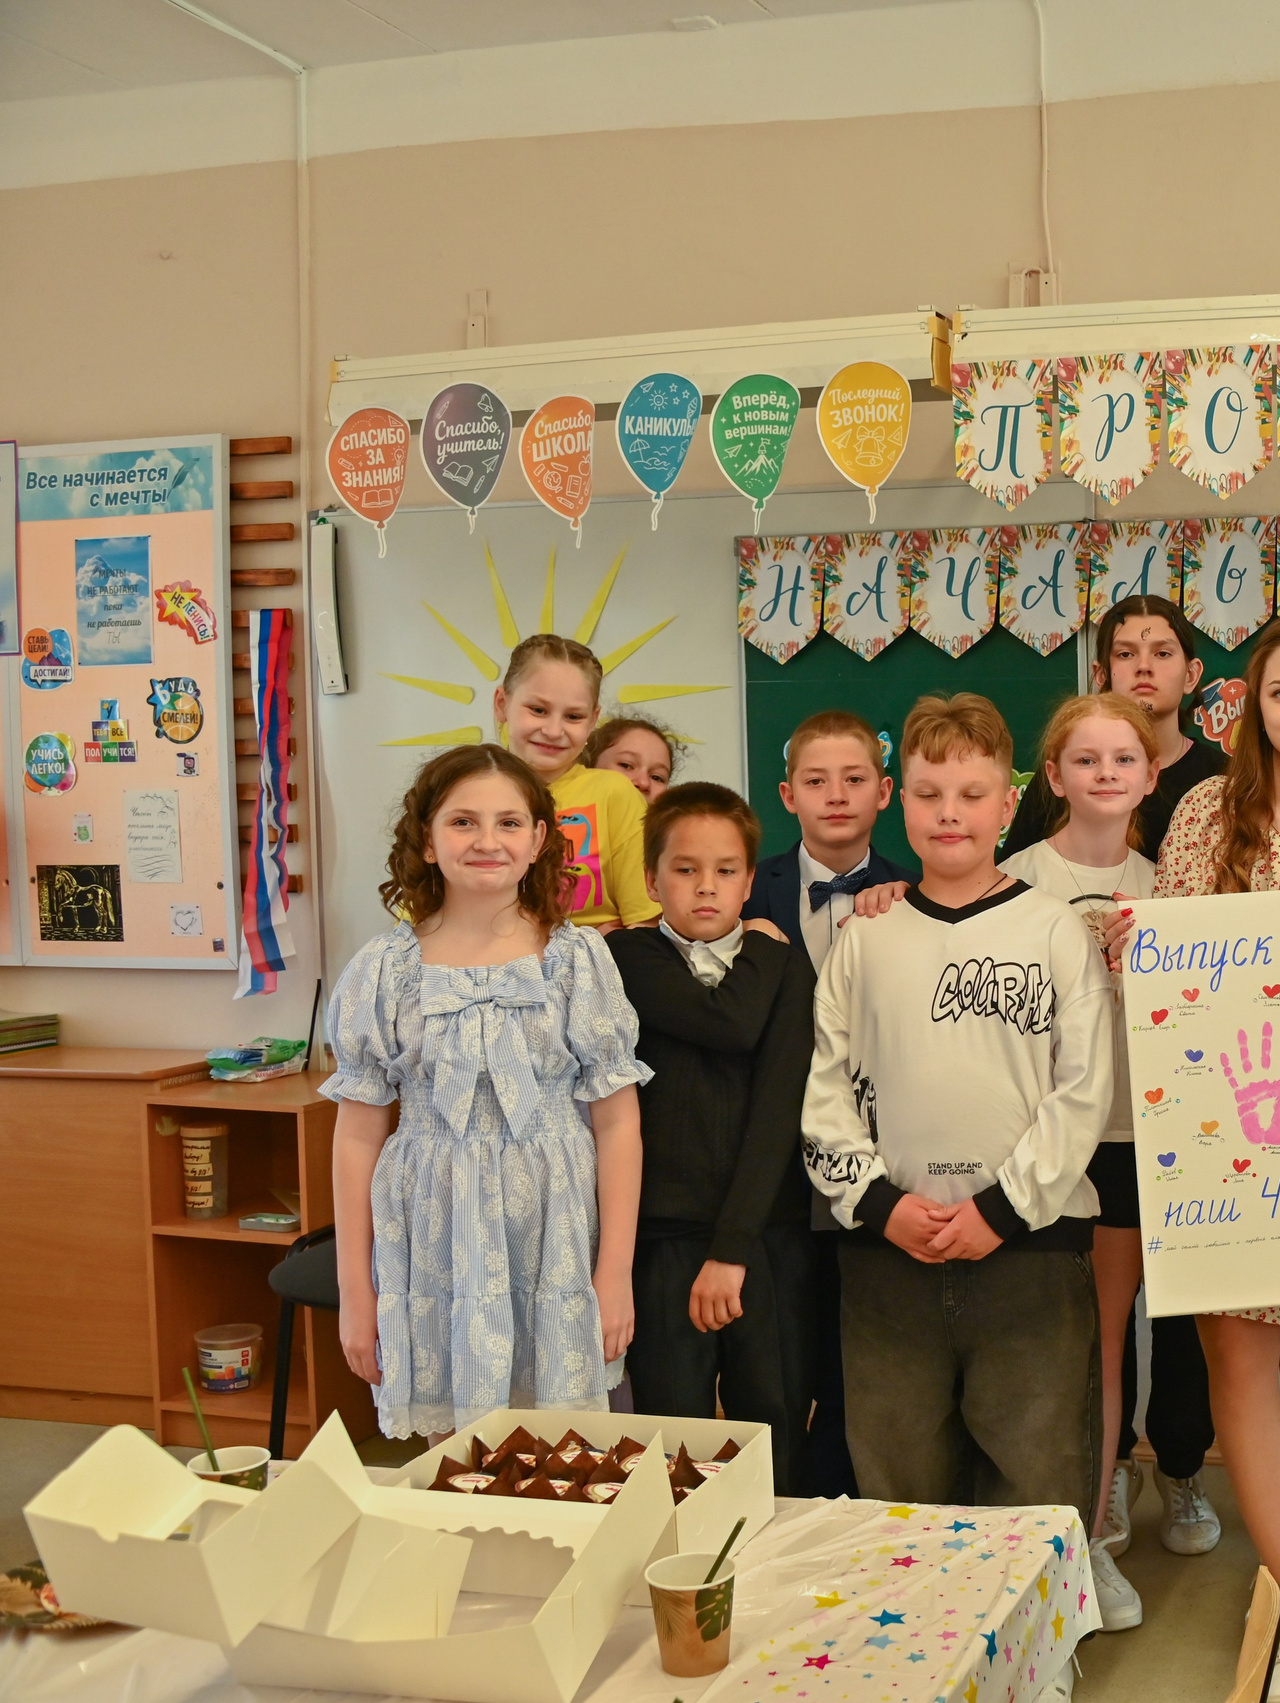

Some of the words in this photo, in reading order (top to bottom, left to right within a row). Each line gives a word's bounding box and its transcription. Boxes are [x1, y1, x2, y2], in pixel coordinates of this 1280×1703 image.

[732, 390, 790, 411] Вперёд,
[829, 387, 903, 406] Последний
[534, 410, 593, 438] Спасибо,
[744, 409, 789, 423] новым
[829, 402, 904, 428] ЗВОНОК!
[434, 415, 501, 442] Спасибо,
[724, 424, 791, 440] вершинам!
[340, 427, 405, 452] СПАСИБО
[436, 432, 505, 465] учитель!
[366, 448, 385, 466] ЗА
[26, 471, 58, 489] Все
[62, 466, 168, 488] начинается
[341, 464, 404, 488] ЗНАНИЯ!
[90, 493, 100, 508] с
[104, 488, 167, 507] мечты
[170, 591, 185, 609] НЕ
[182, 601, 211, 640] ЛЕНИСЬ!
[28, 636, 49, 645] СТАВЬ
[28, 644, 49, 654] ЦЕЛИ!
[33, 667, 70, 678] ДОСТИГАЙ!
[161, 711, 199, 724] СМЕЛЕЙ!
[30, 748, 64, 761] УЧИСЬ
[31, 761, 66, 775] ЛЕГКО!
[966, 1161, 983, 1169] AND
[1164, 1198, 1242, 1228] наш
